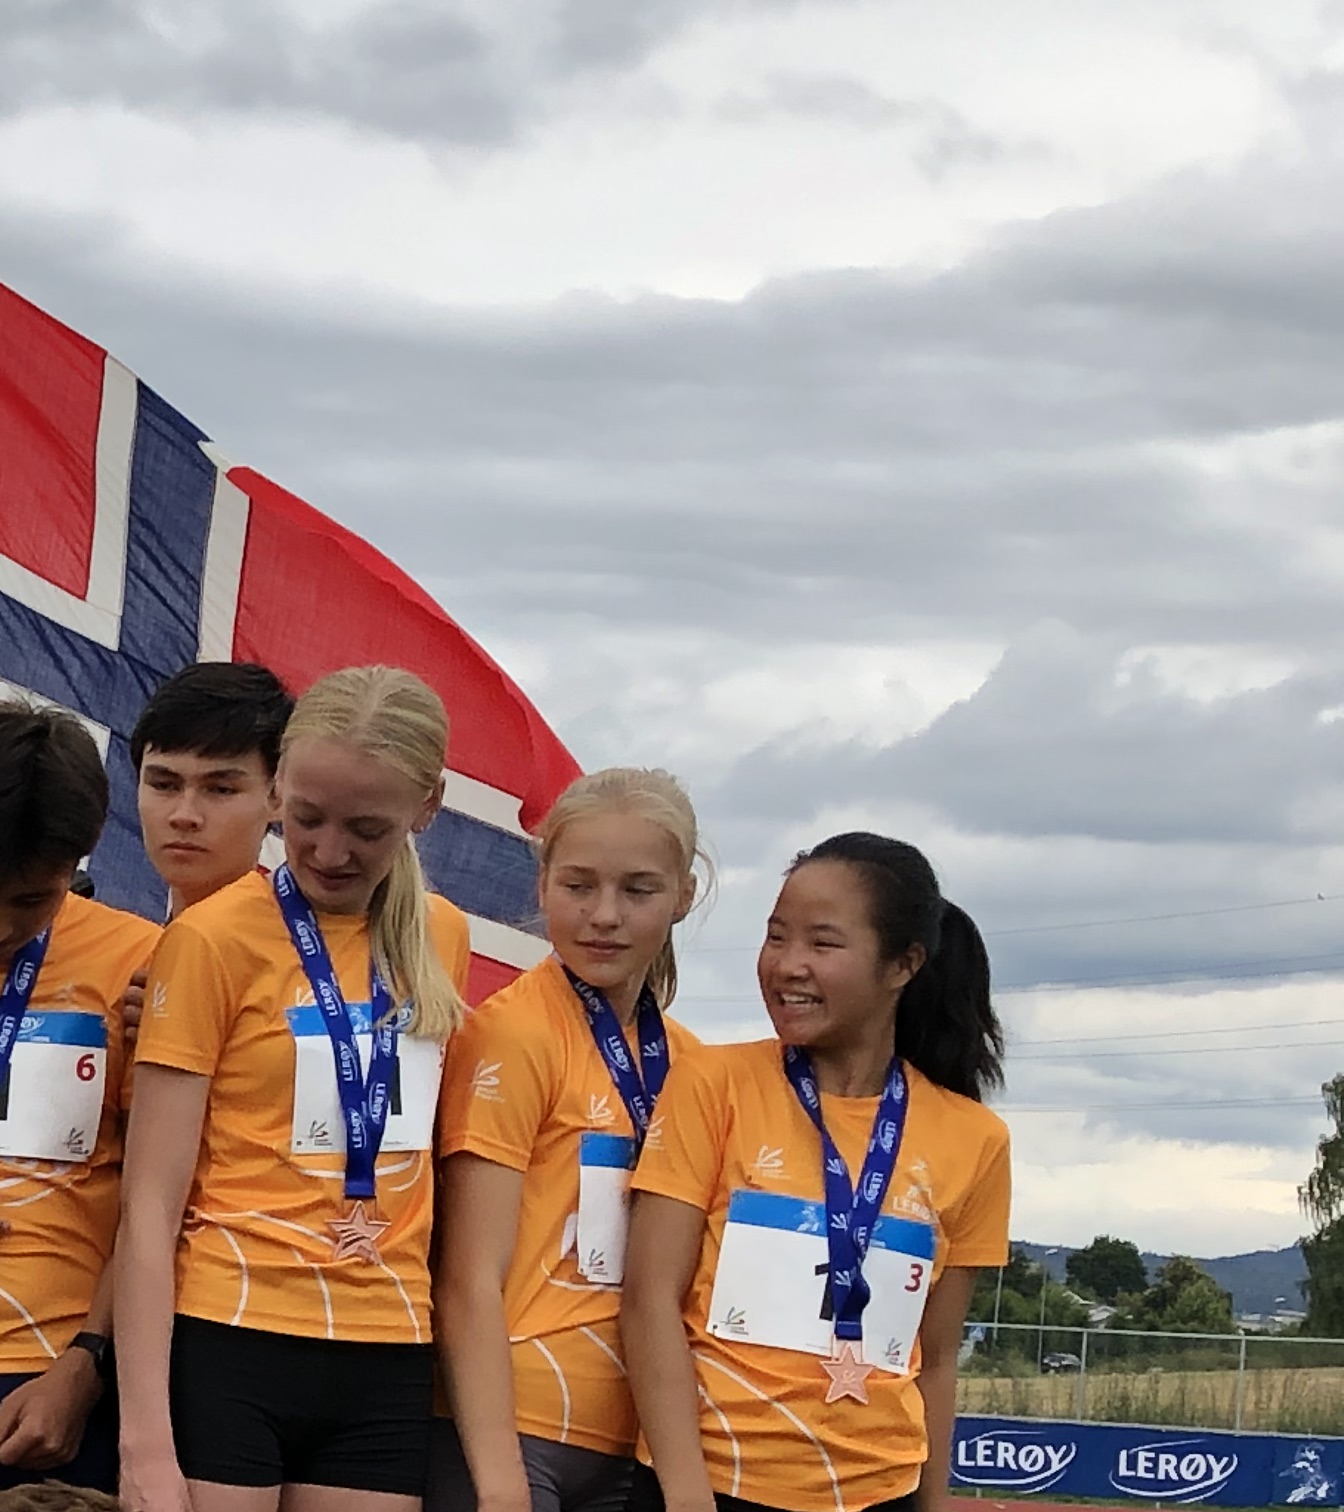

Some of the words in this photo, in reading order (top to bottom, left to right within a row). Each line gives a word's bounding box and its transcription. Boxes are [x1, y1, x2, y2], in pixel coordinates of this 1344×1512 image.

[76, 1054, 96, 1081] 6
[905, 1264, 922, 1292] 3
[958, 1440, 1068, 1472] LERØY
[1119, 1449, 1231, 1481] LERØY
